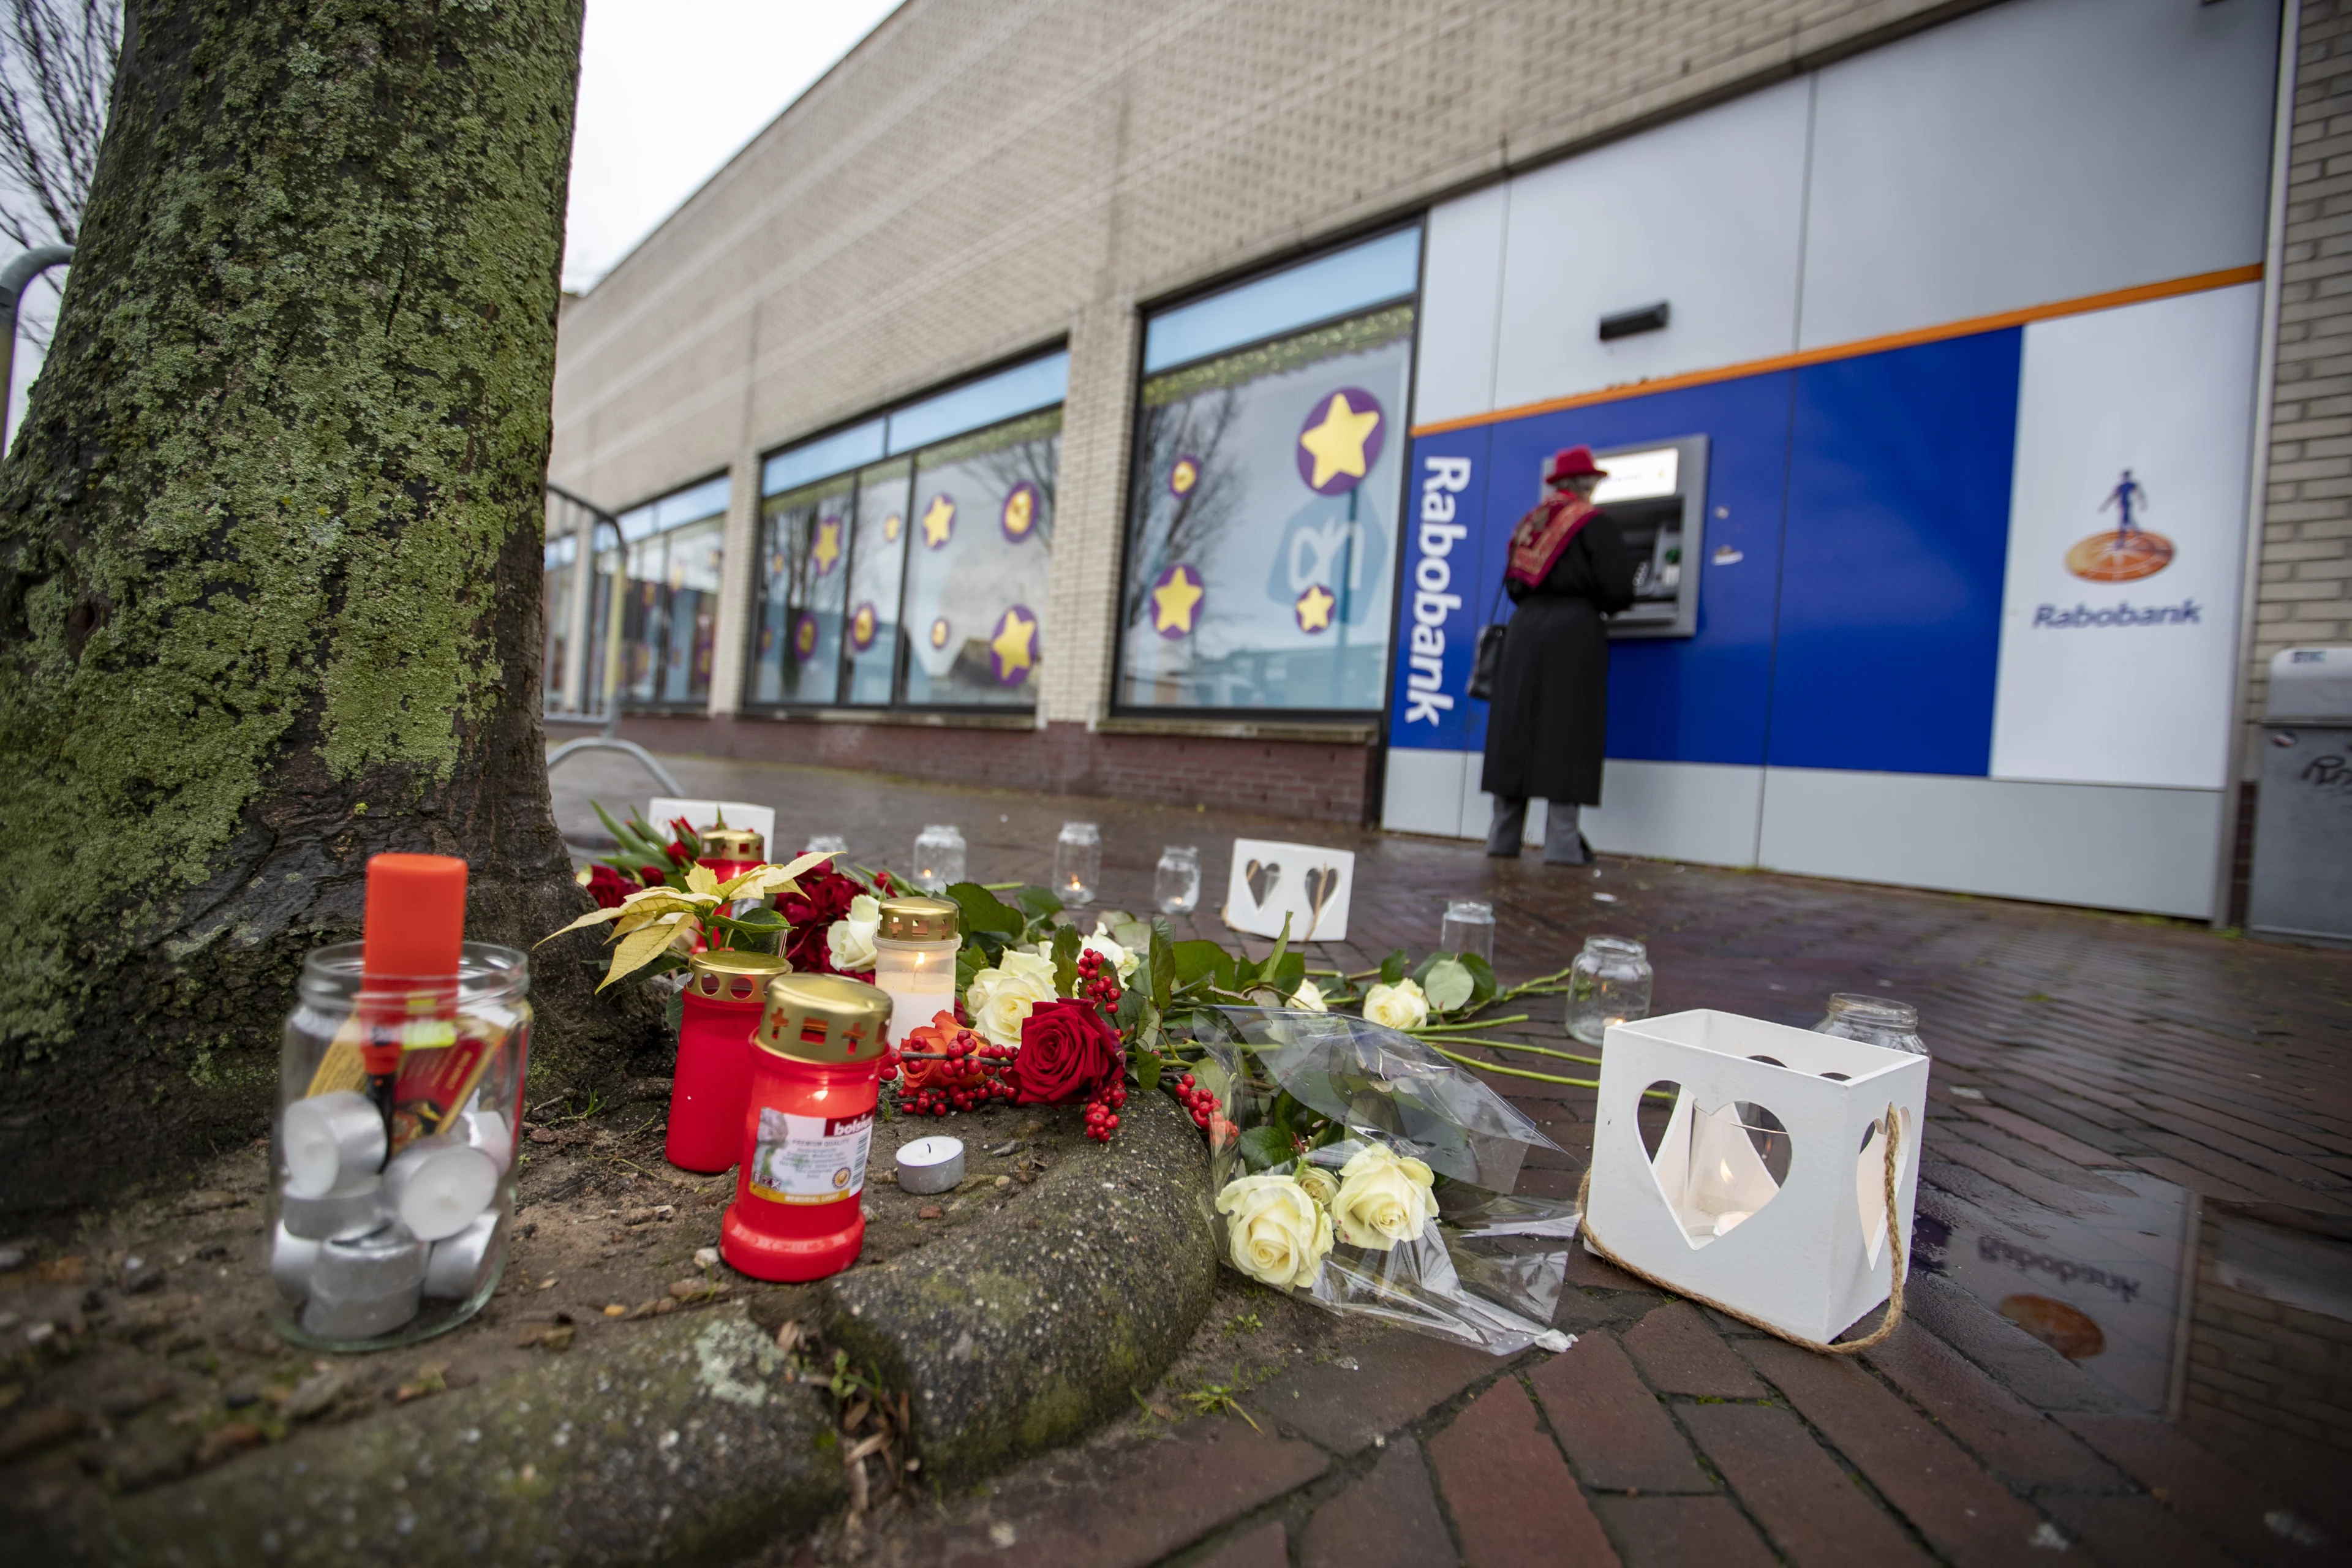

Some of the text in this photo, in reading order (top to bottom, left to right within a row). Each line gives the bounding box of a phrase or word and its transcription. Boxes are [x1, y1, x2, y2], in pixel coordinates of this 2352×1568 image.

[1404, 456, 1471, 726] Rabobank
[2031, 598, 2201, 629] Rabobank
[824, 1139, 849, 1147] QUALITY
